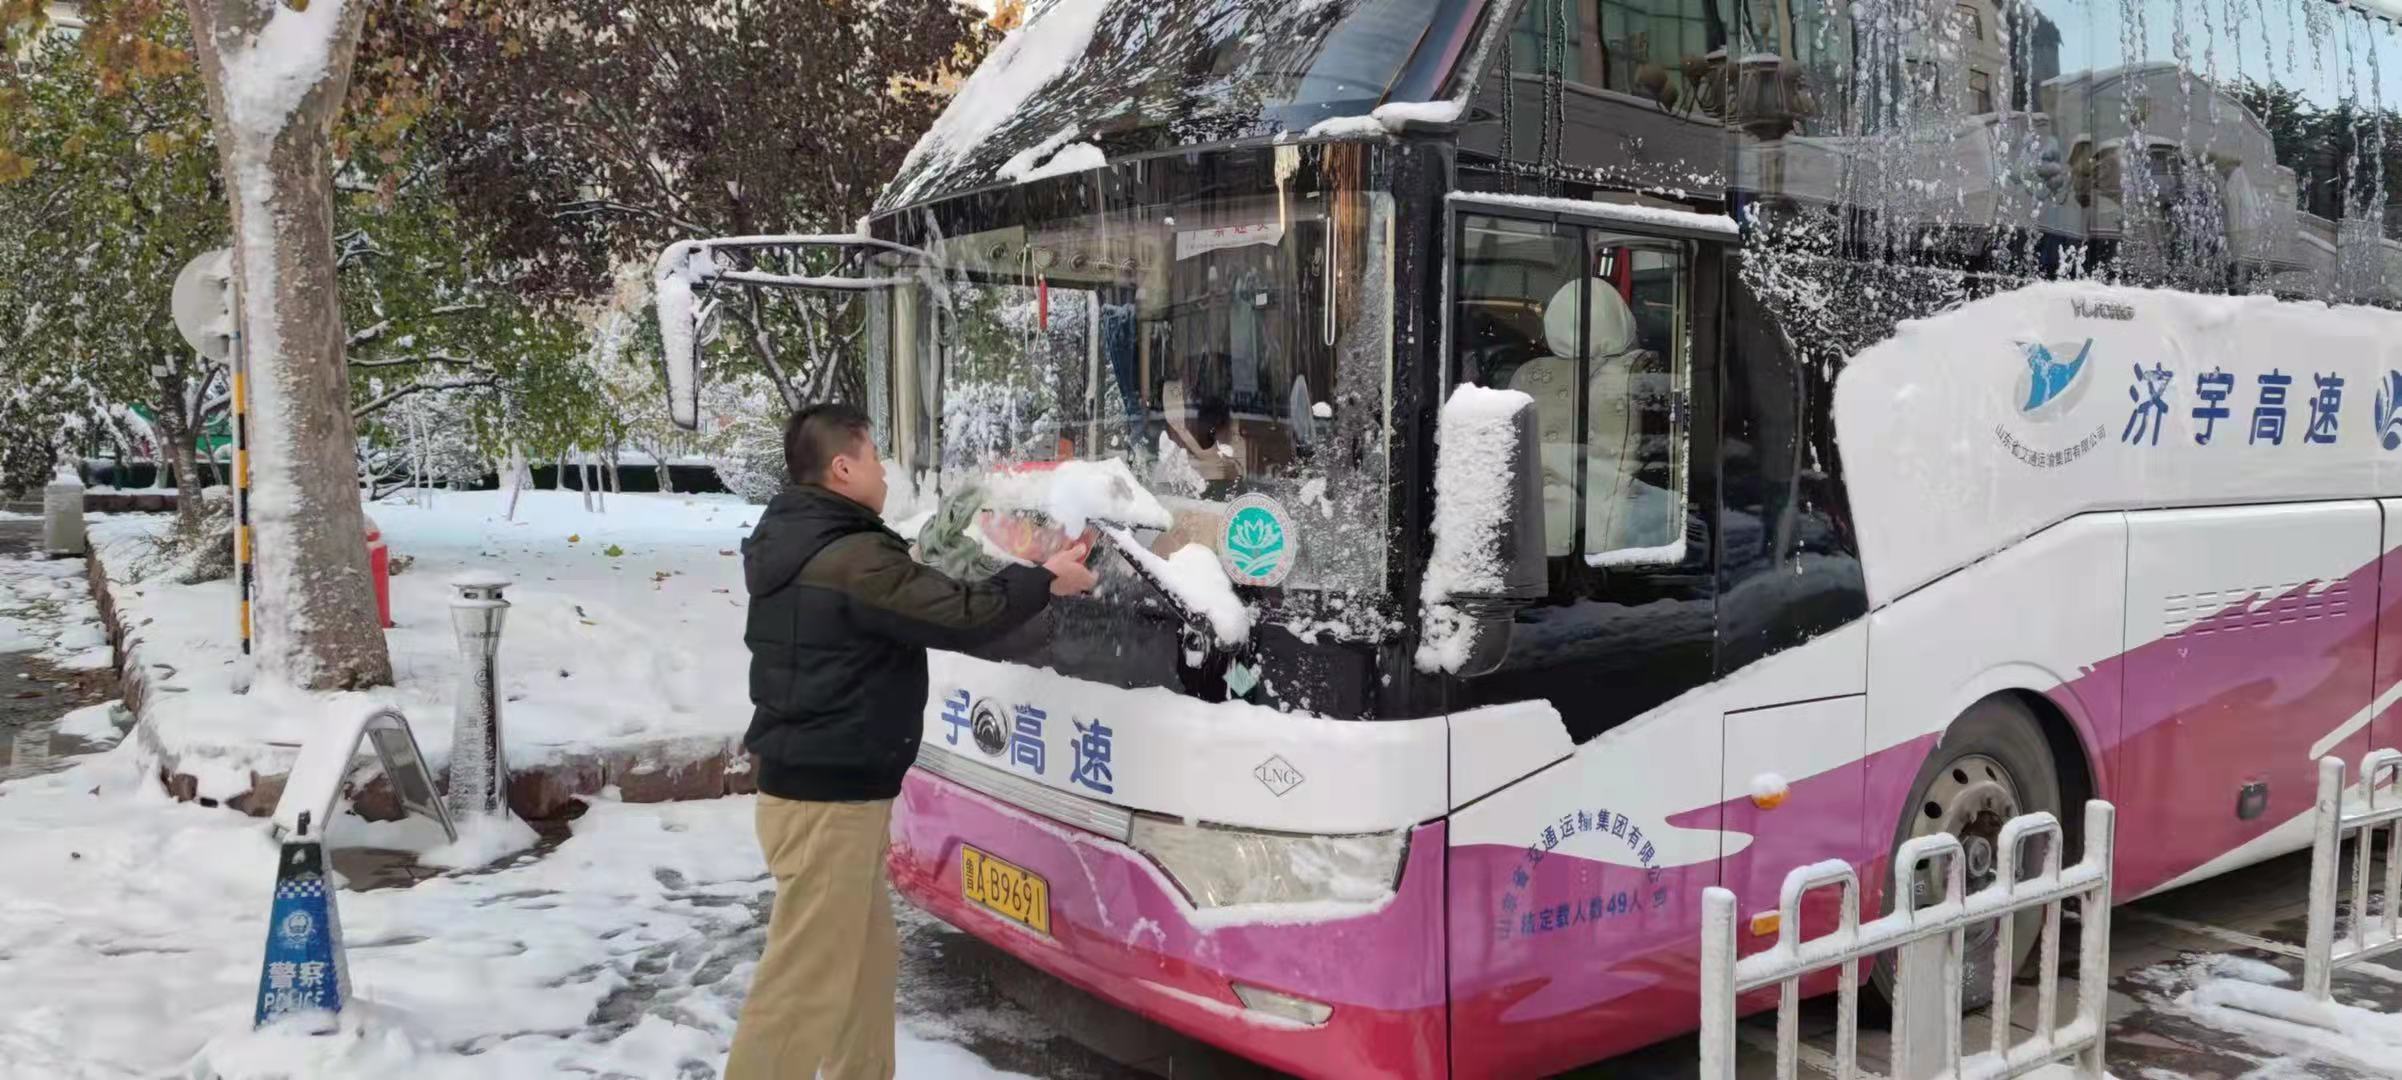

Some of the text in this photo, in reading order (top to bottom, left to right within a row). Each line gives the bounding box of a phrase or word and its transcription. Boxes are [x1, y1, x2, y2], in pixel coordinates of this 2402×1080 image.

[2122, 362, 2344, 446] 济宇高速
[1261, 768, 1296, 786] LNG
[268, 961, 327, 988] 警察
